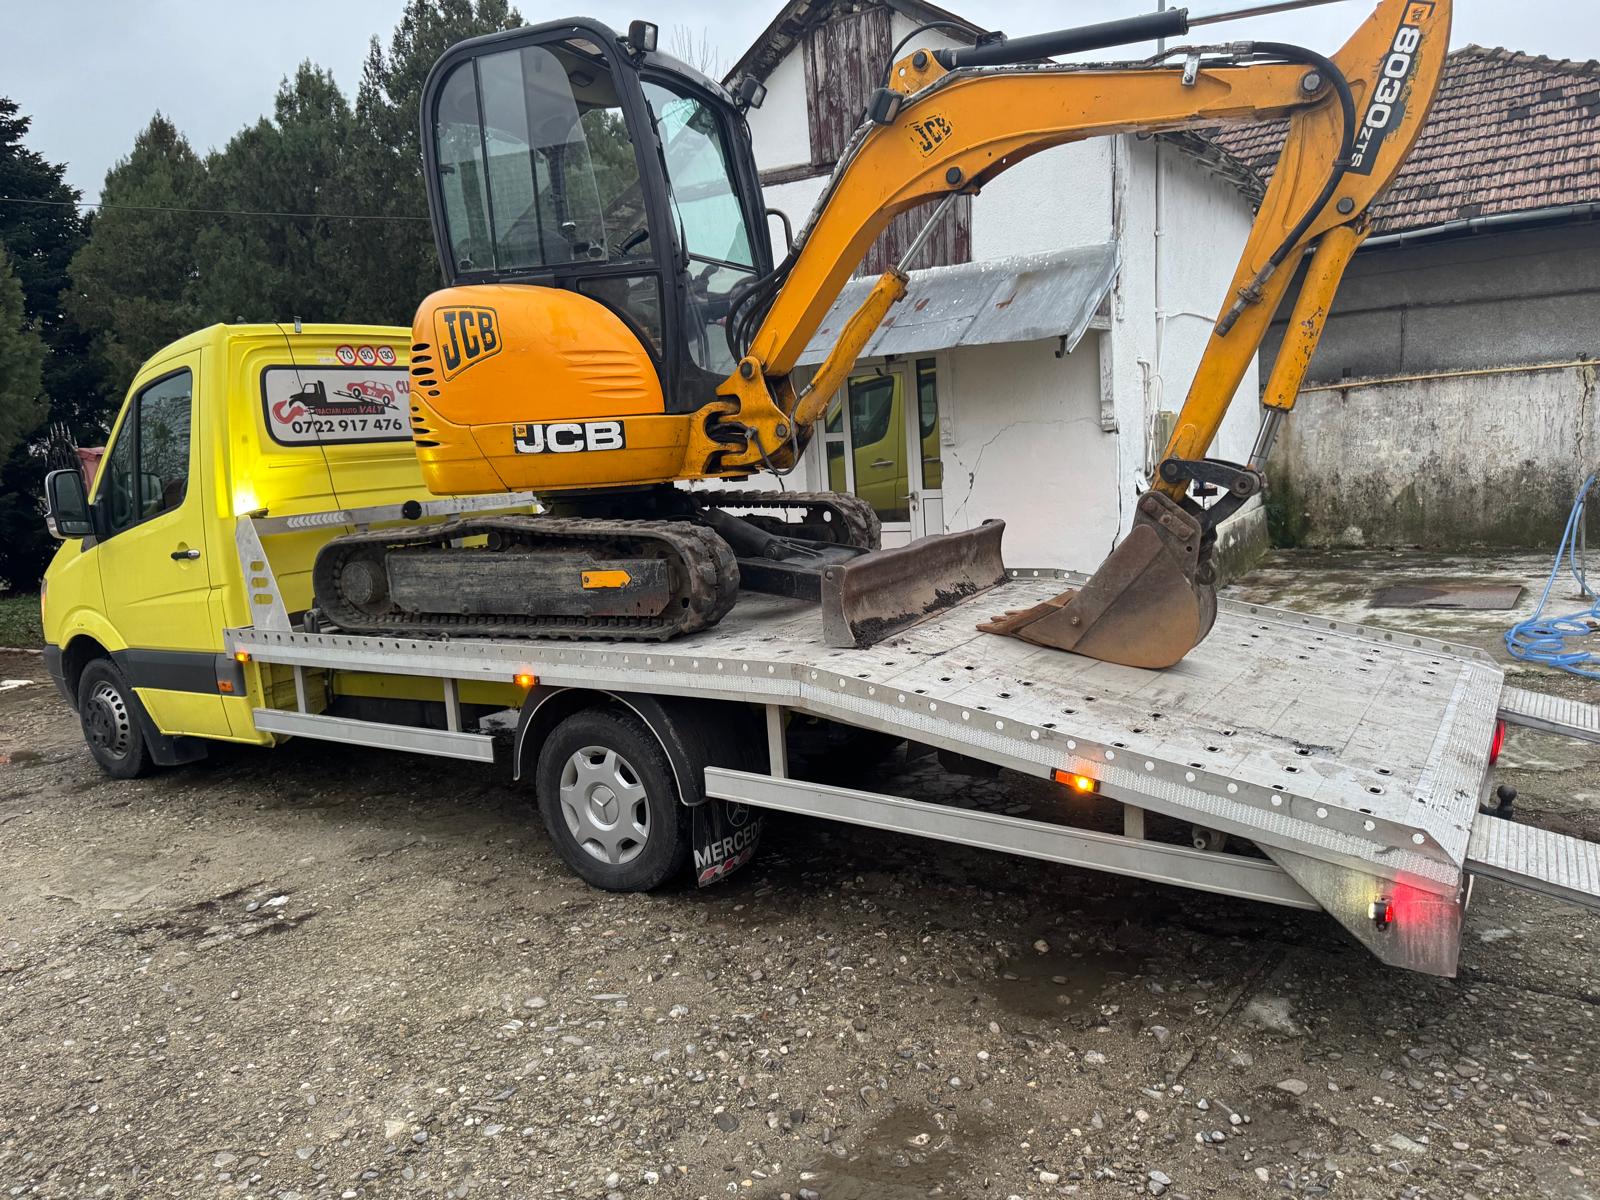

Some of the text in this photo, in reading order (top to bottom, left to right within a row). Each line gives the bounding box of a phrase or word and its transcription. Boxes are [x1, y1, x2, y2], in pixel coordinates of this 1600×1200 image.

[1365, 27, 1421, 129] 8030
[912, 116, 952, 152] JCB
[1351, 127, 1373, 168] ZTS
[339, 350, 353, 360] 70
[360, 350, 373, 360] 90
[379, 350, 394, 360] 130
[442, 310, 497, 371] JCB
[292, 420, 335, 434] 0722
[338, 419, 368, 431] 917
[373, 418, 402, 431] 476
[359, 404, 383, 414] VALY
[516, 420, 624, 454] JCB
